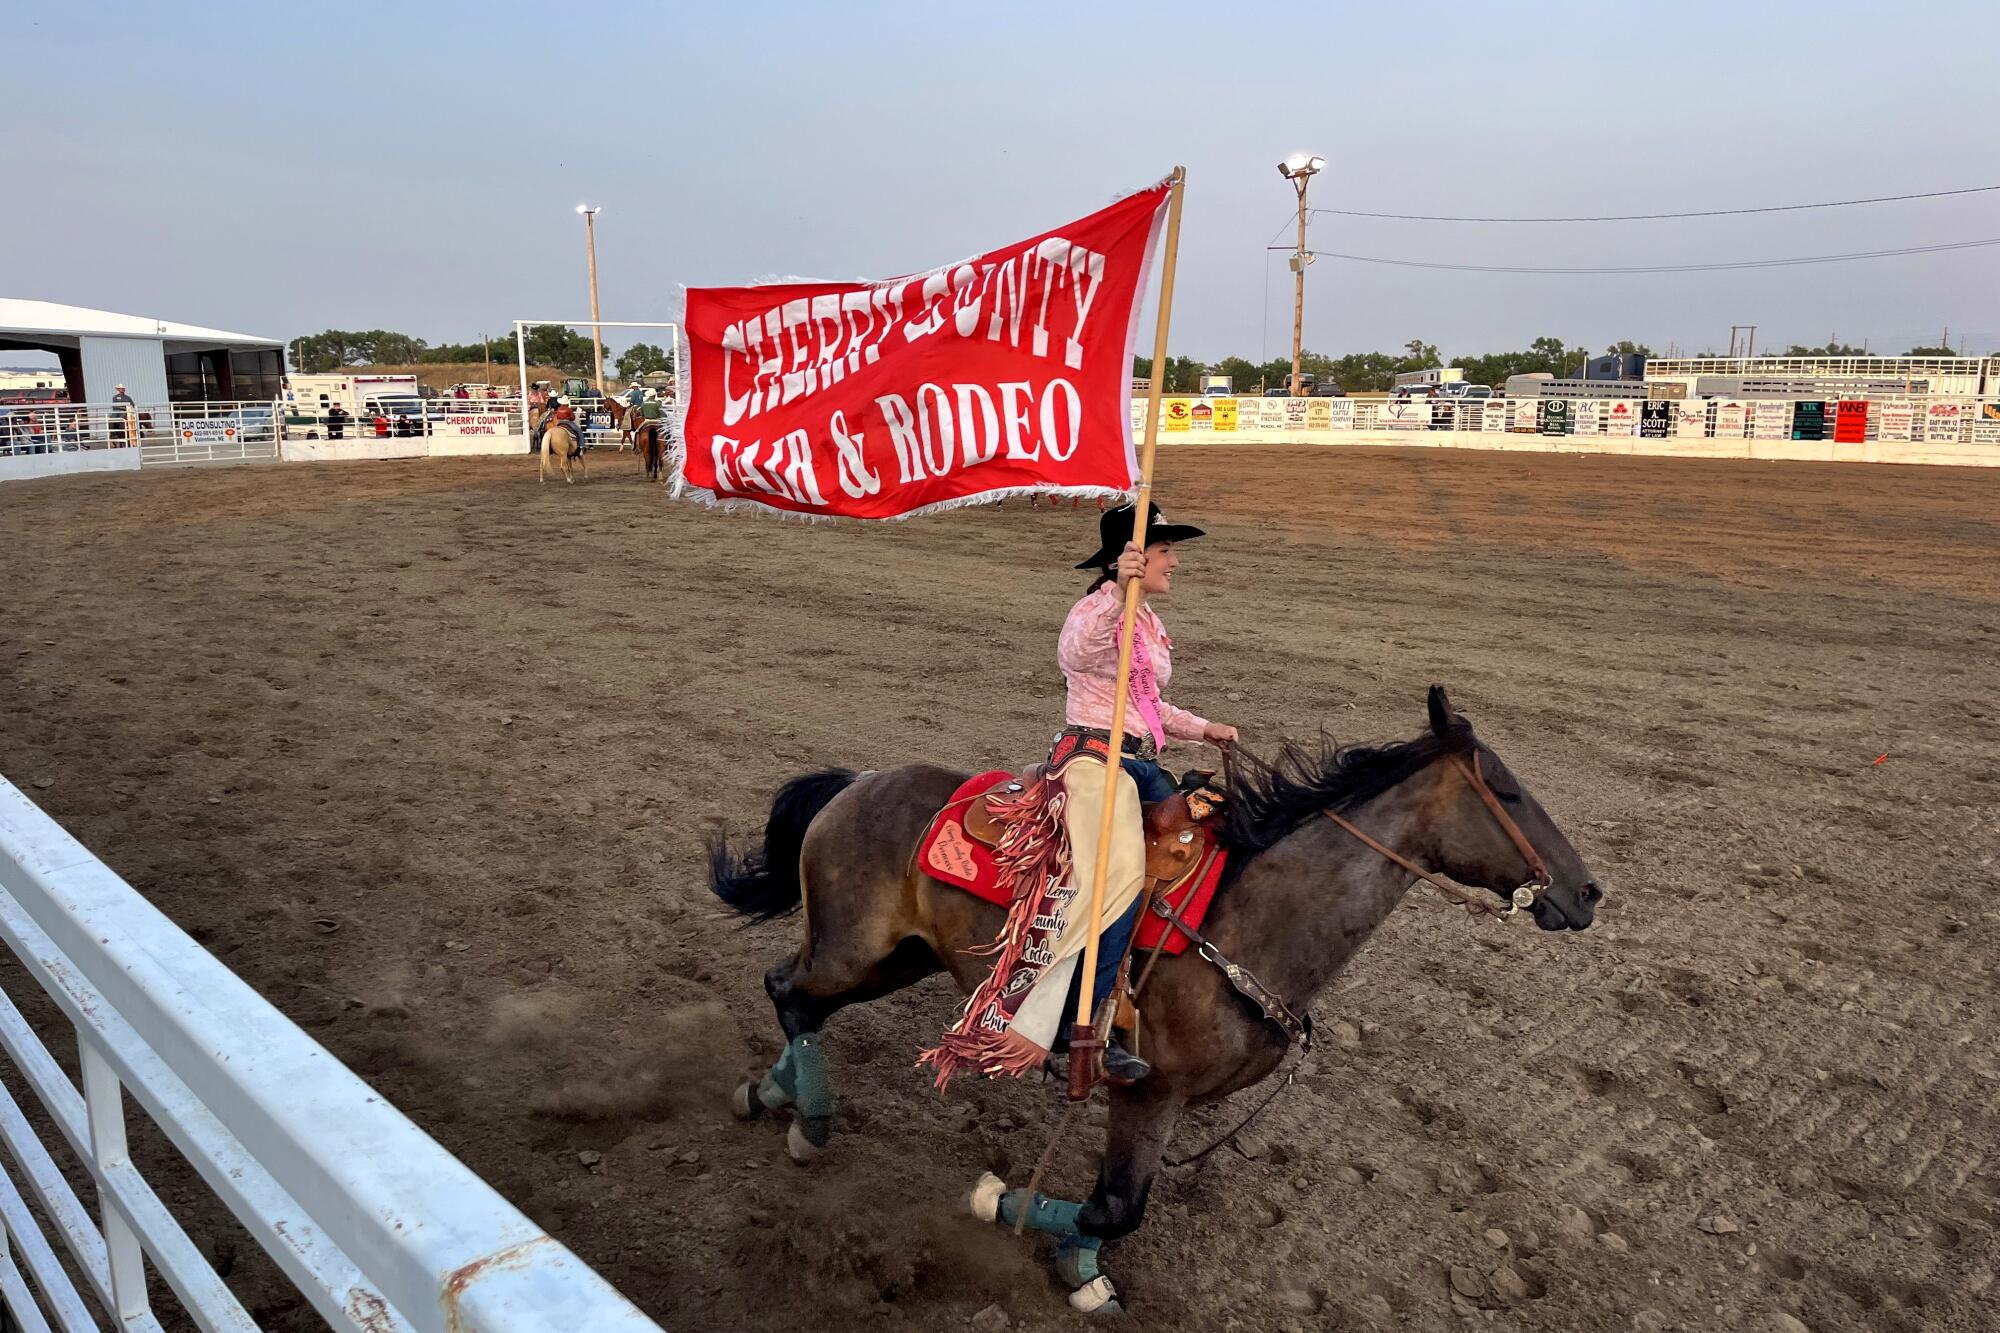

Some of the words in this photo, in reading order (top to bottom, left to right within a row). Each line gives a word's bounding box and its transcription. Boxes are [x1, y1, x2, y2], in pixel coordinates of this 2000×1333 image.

[722, 285, 904, 426] CHERRY
[1333, 401, 1352, 409] WITT
[1647, 401, 1665, 410] ERIC
[1840, 402, 1865, 413] WNB
[1651, 410, 1659, 418] A.
[182, 421, 195, 430] DJR
[196, 420, 235, 430] CONSULTING
[446, 416, 475, 425] CHERRY
[477, 416, 506, 425] COUNTY
[1642, 418, 1667, 428] SCOTT
[460, 426, 495, 435] HOSPITAL
[711, 428, 829, 505] FAIR
[830, 409, 881, 499] &
[876, 378, 1082, 484] RODEO
[1031, 908, 1067, 939] ounty
[1022, 934, 1056, 964] Rodeo
